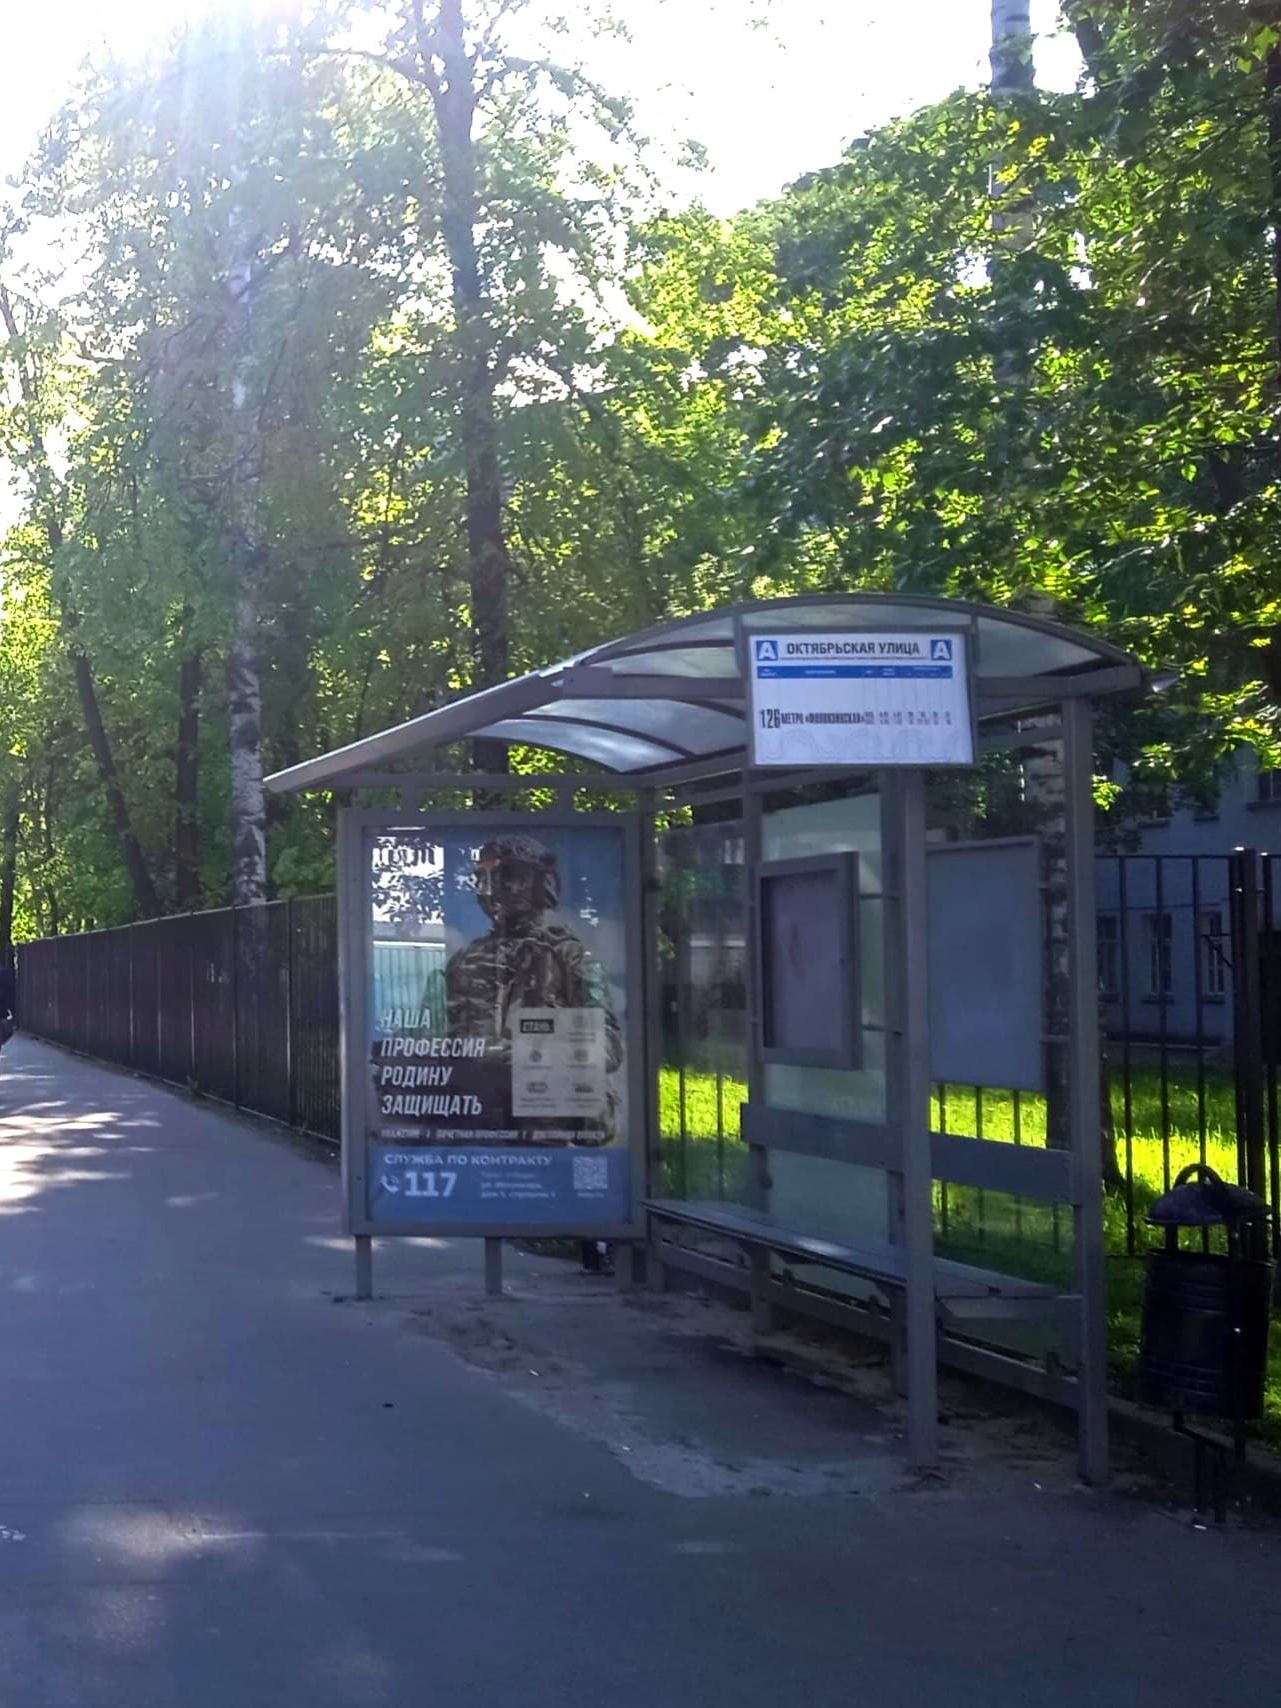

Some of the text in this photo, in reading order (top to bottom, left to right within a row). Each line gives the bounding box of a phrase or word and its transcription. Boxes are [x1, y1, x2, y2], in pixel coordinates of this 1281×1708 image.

[786, 642, 876, 655] ОКТЯБРЬСКАЯ
[879, 642, 921, 656] УЛИЦА
[760, 708, 780, 729] 126
[382, 1008, 431, 1029] НАША
[380, 1037, 486, 1058] ПРОФЕССИЯ
[380, 1065, 454, 1088] РОДИНУ
[381, 1094, 483, 1117] ЗАЩИЩАТЬ
[384, 1153, 552, 1167] СЛУЖБА ПО КОНТРАКТУ
[404, 1171, 458, 1197] 117
